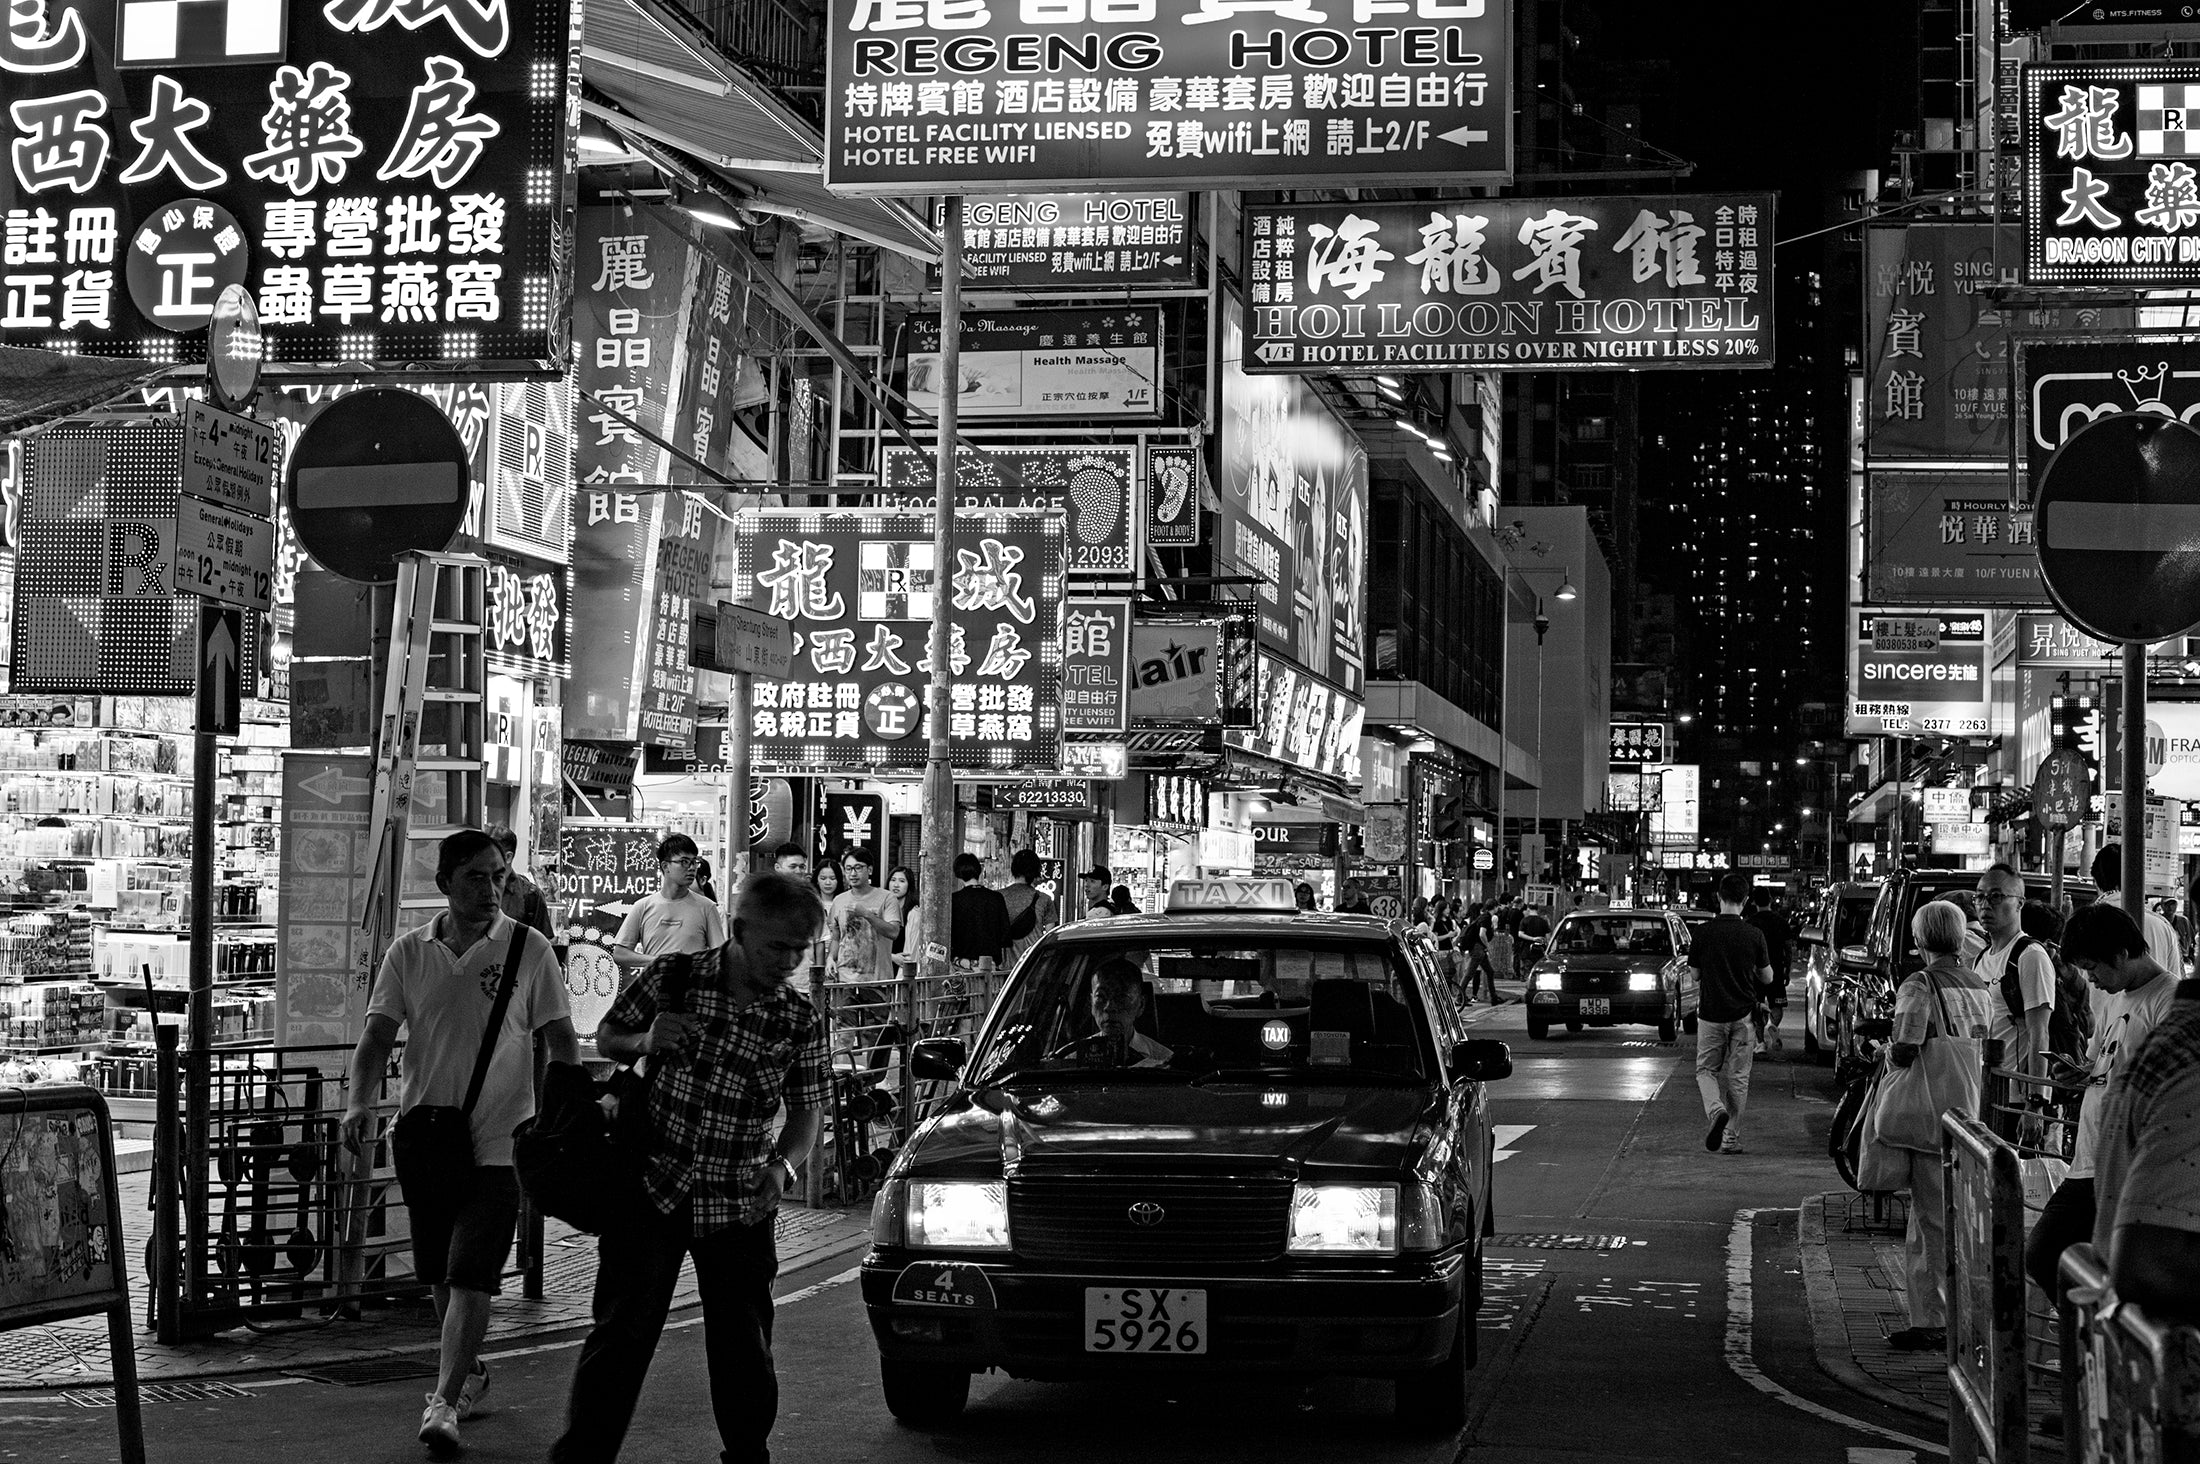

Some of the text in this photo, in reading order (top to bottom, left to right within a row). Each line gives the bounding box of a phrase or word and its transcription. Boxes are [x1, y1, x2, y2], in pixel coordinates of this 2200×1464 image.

[853, 25, 1483, 78] REGENG HOTEL
[844, 71, 1488, 119] 持牌賓館 酒店設備 豪華套房 歡迎自由行
[9, 55, 500, 195] 西大藥房
[2044, 85, 2133, 160] 龍
[843, 124, 920, 145] HOTEL
[926, 121, 1029, 145] FACILITY
[1033, 119, 1132, 142] LIENSED
[1145, 118, 1310, 161] 免費wifi上網
[843, 144, 1036, 168] HOTEL FREE WIFI
[2056, 162, 2200, 233] 大藥
[1084, 198, 1184, 224] HOTEL
[3, 206, 117, 266] 註冊
[262, 192, 506, 258] 專營批發
[993, 224, 1183, 249] 酒店設備 豪華套房 歡迎自由行
[967, 252, 1007, 265] FACILITY
[1008, 251, 1047, 264] LIENSED
[1252, 215, 1271, 303] 酒店設備
[1275, 216, 1296, 303] 純粹租房
[1306, 208, 1707, 300] 海龍賓館
[1714, 205, 1735, 293] 全日特平
[1737, 204, 1759, 295] 時租過夜
[2046, 236, 2176, 265] DRAGON CITY
[989, 265, 1010, 277] WIFI
[1953, 262, 1994, 276] SING
[153, 252, 217, 316] 正
[258, 262, 500, 325] 蟲草燕窩
[0, 270, 117, 330] 正貨
[978, 318, 1040, 337] Massage
[1252, 297, 1760, 340] HOI LOON HOTEL
[1039, 331, 1149, 347] 慶達養生館
[1264, 337, 1760, 363] 1/F HOTEL FACILITEIS OVER NIGHT LESS 20%
[1033, 354, 1127, 368] Health Massage
[584, 234, 655, 527] 麗晶賓館
[1041, 388, 1149, 402] 正宗穴位按摩 1/F
[1954, 404, 1979, 413] 10/F
[229, 422, 269, 465] midnight 12
[232, 440, 248, 461] 午夜
[193, 450, 216, 471] Except
[238, 465, 264, 486] Holidays
[199, 508, 224, 528] General
[1963, 502, 2006, 511] HOURLY
[1153, 524, 1191, 537] FOOT & BODY
[207, 531, 243, 558] 公眾假期
[1078, 546, 1125, 563] 2093
[664, 540, 710, 576] REGENG
[178, 547, 269, 600] noon midnight 12
[178, 564, 245, 598] 中午 午夜
[664, 571, 701, 599] HOTEL
[757, 538, 1036, 623] 龍 城
[1975, 568, 1997, 578] 10/F
[2001, 568, 2030, 579] YUEN
[762, 621, 779, 639] Street
[1875, 638, 1917, 650] 60380538
[2053, 648, 2088, 657] SING YUET
[1065, 665, 1118, 686] TEL
[1863, 663, 1978, 681] sincere 先施
[753, 682, 862, 711] 政府註冊
[922, 683, 1035, 713] 營批發
[1855, 703, 1910, 716] 租務熱線
[643, 710, 664, 731] HOTEL
[663, 713, 681, 733] FREE
[876, 704, 906, 735] 正
[1079, 708, 1116, 716] LIENSED
[1086, 717, 1115, 725] WIFI
[1882, 718, 1987, 730] TEL: 2377 2263
[921, 712, 1034, 742] 草燕窩
[1018, 791, 1084, 804] 62213330
[592, 875, 655, 895] PALACE
[1177, 881, 1290, 905] TAXI
[568, 952, 616, 998] 38
[1263, 1027, 1288, 1042] TAXI
[934, 1270, 954, 1290] 4
[914, 1289, 975, 1306] SEATS
[1120, 1289, 1171, 1321] SX
[1092, 1319, 1199, 1352] 5926
